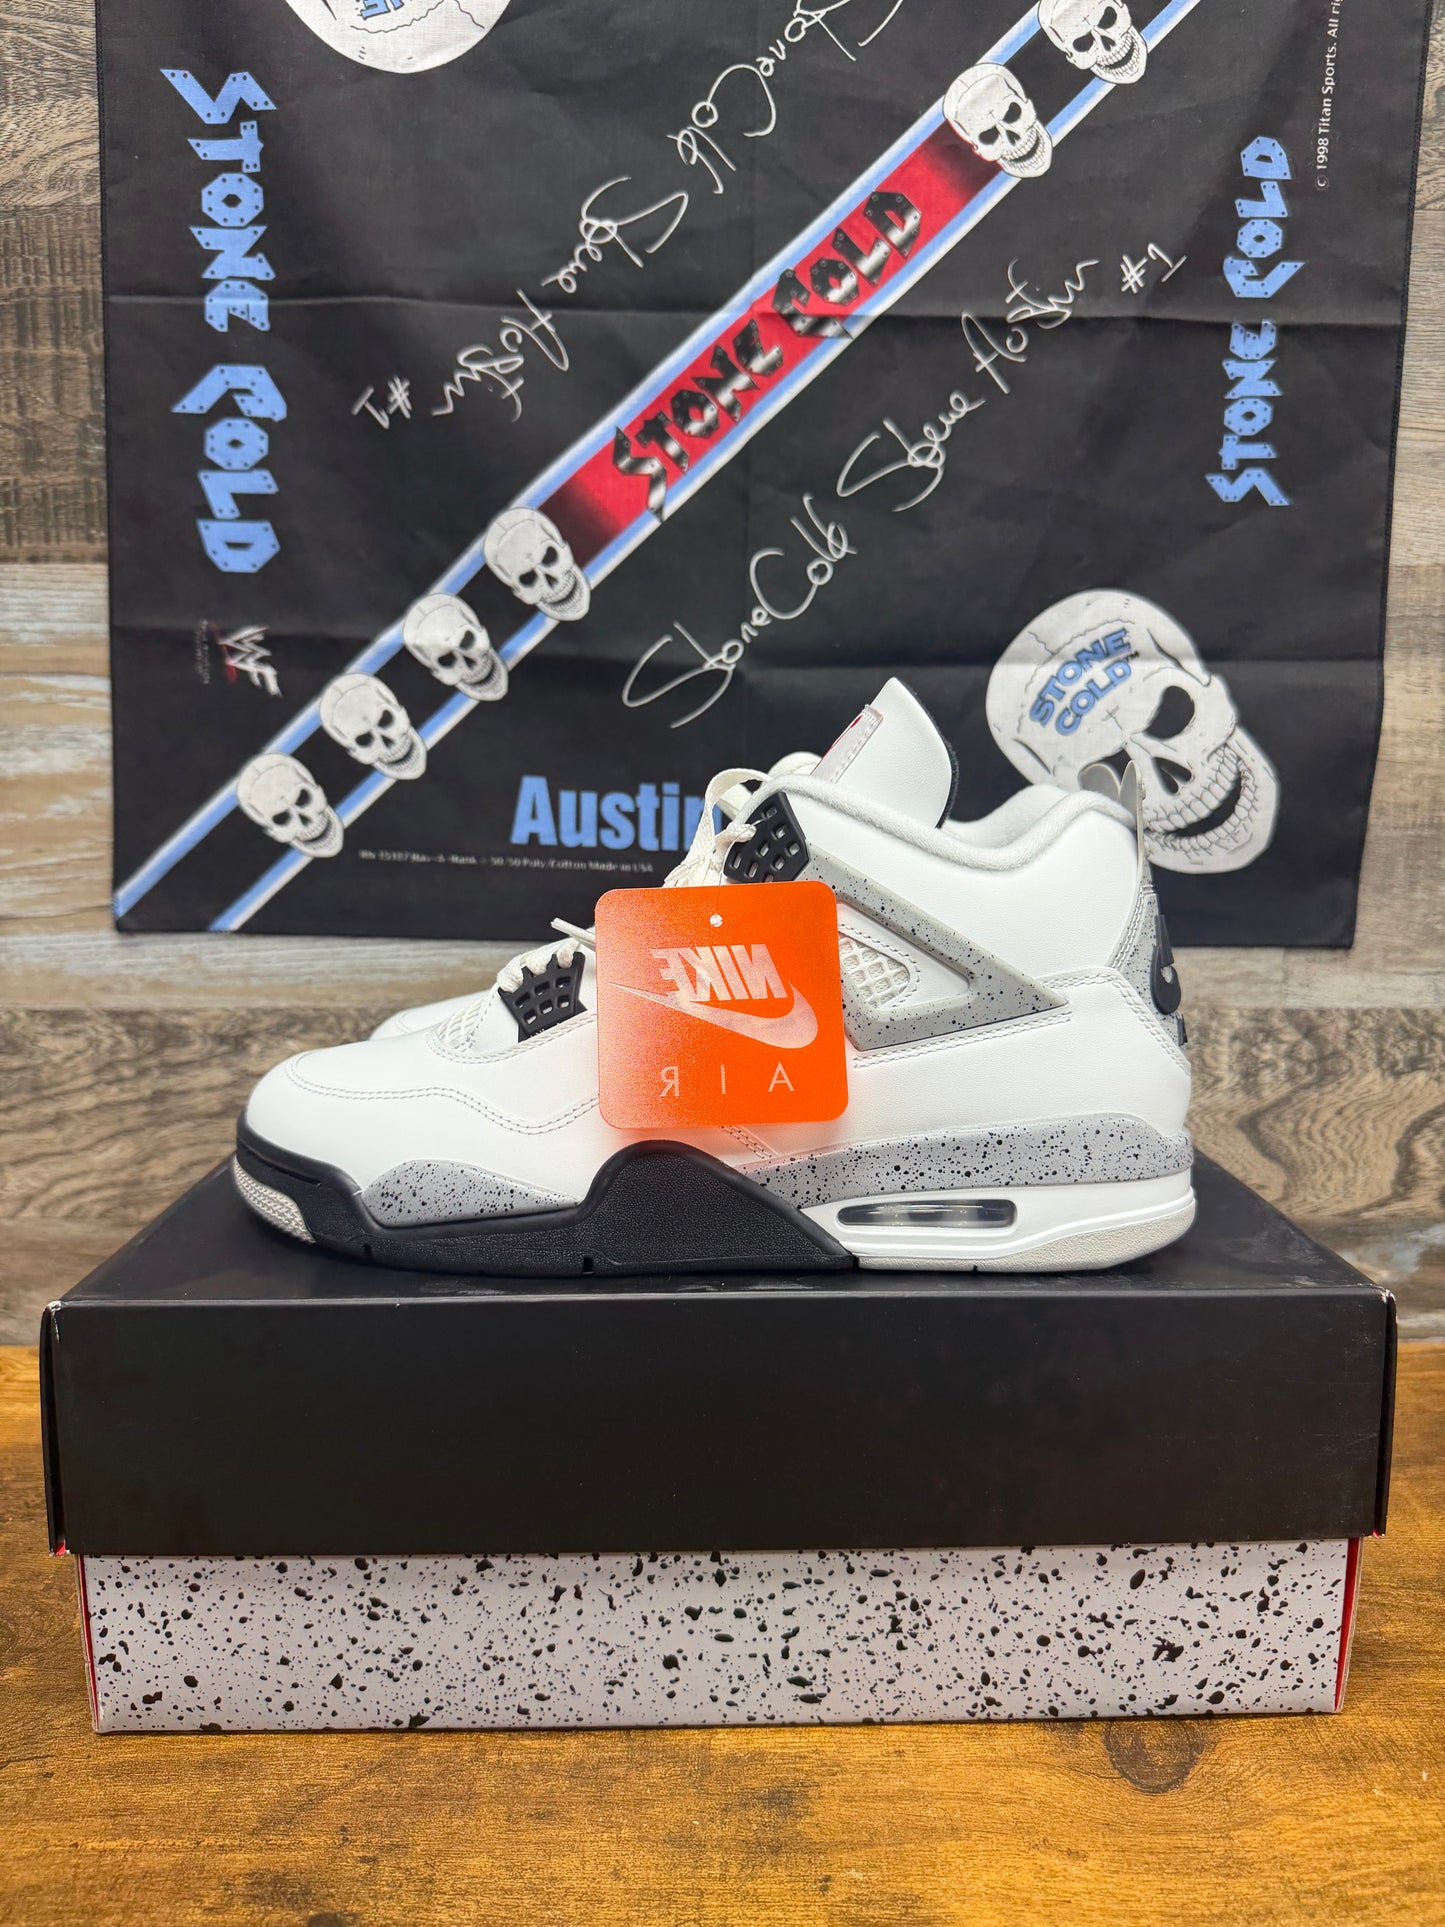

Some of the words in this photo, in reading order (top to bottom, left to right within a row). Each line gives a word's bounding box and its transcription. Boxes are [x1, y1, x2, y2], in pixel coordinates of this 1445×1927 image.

[1321, 42, 1338, 94] Sports.
[1327, 18, 1340, 39] All
[1316, 137, 1330, 170] 1998
[1318, 98, 1332, 134] Titan
[161, 69, 277, 332] STONE
[1223, 136, 1305, 299] COLD
[611, 318, 784, 522] STONE
[771, 189, 923, 339] COLD
[1206, 319, 1291, 507] STONE
[171, 365, 287, 573] COLD
[1028, 626, 1132, 728] STONE
[1054, 658, 1133, 737] COLD
